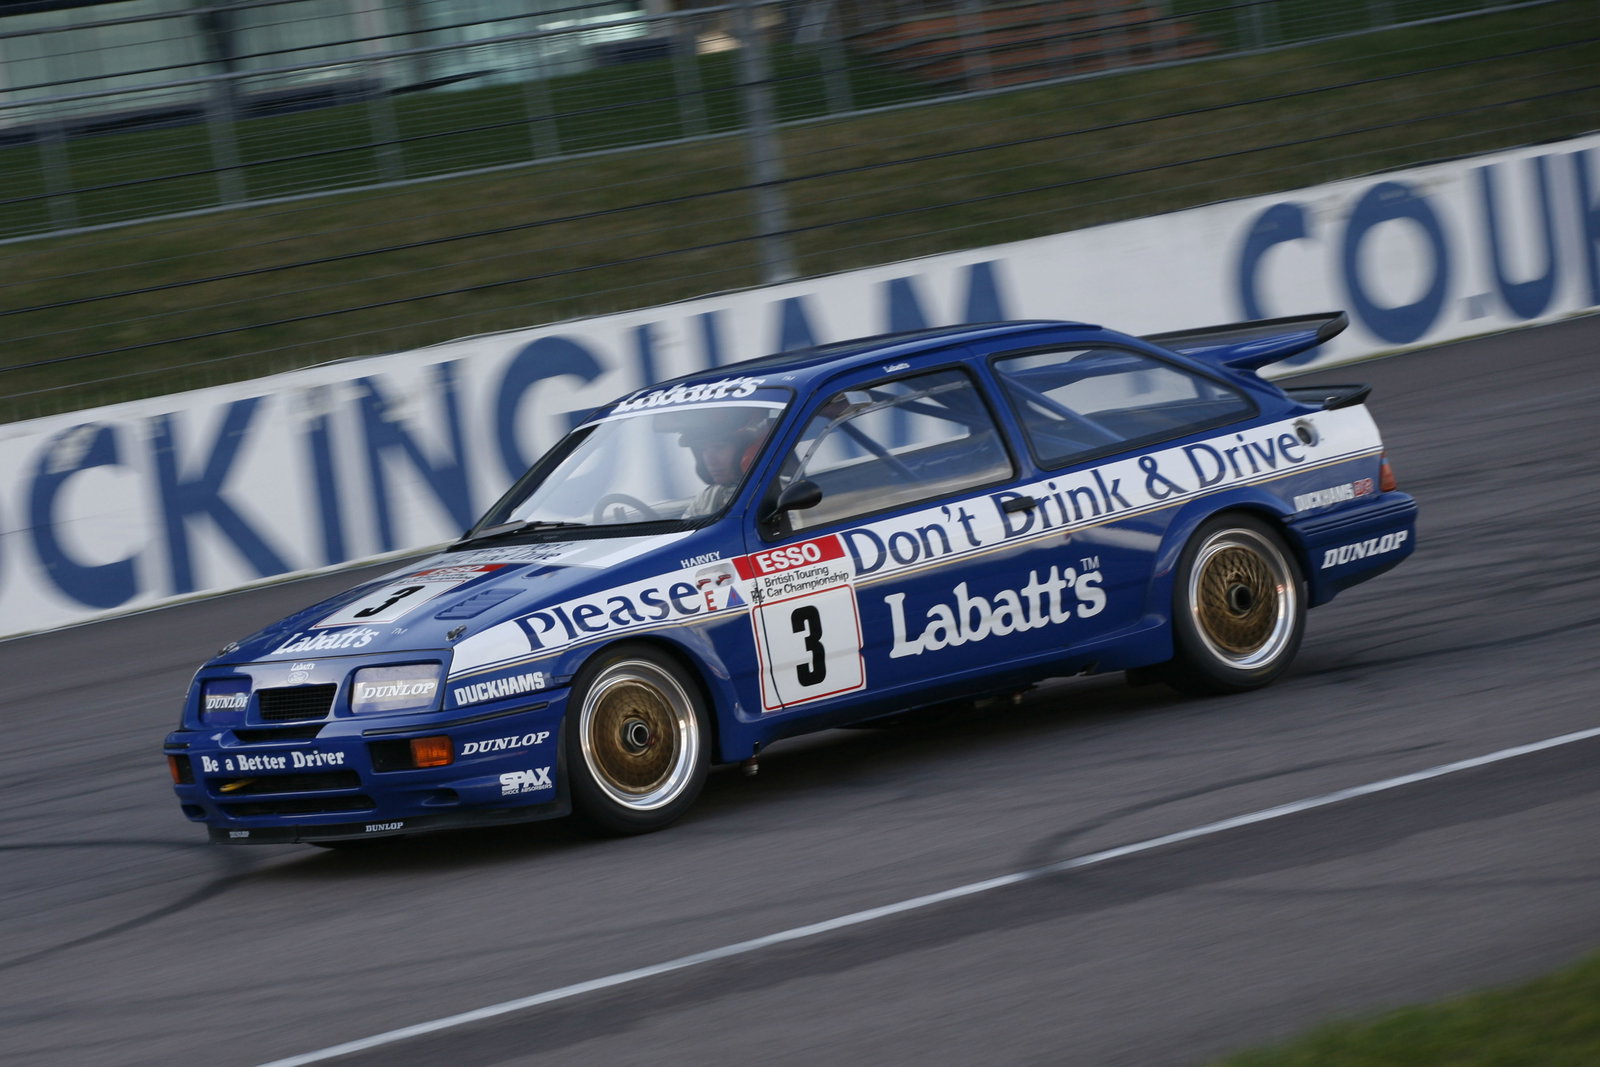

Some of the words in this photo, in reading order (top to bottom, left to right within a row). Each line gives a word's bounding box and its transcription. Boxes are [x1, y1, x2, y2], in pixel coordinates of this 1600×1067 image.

[610, 376, 766, 414] Labatt's
[848, 502, 982, 578] Don't
[990, 468, 1133, 538] Drink
[1138, 455, 1189, 500] &
[1183, 428, 1307, 488] Drive
[680, 551, 721, 568] HARVEY
[756, 542, 821, 573] ESSO
[1320, 530, 1409, 569] DUNLOP
[764, 573, 797, 588] British
[796, 565, 830, 583] Touring
[767, 586, 784, 598] Car
[783, 571, 849, 595] Championship
[353, 585, 426, 619] 3
[884, 564, 1107, 658] Labatt's
[1080, 556, 1100, 571] TM
[513, 582, 702, 652] Please
[270, 630, 380, 656] Labatt's
[790, 605, 827, 688] 3
[360, 681, 436, 700] DUNLOP
[453, 671, 546, 706] DUCKHAMS
[460, 731, 550, 756] DUNLOP
[201, 755, 219, 772] Be
[225, 758, 235, 771] a
[236, 754, 287, 771] Better
[291, 750, 346, 768] Driver
[499, 766, 552, 791] SPAX
[365, 822, 404, 833] DUNLOP
